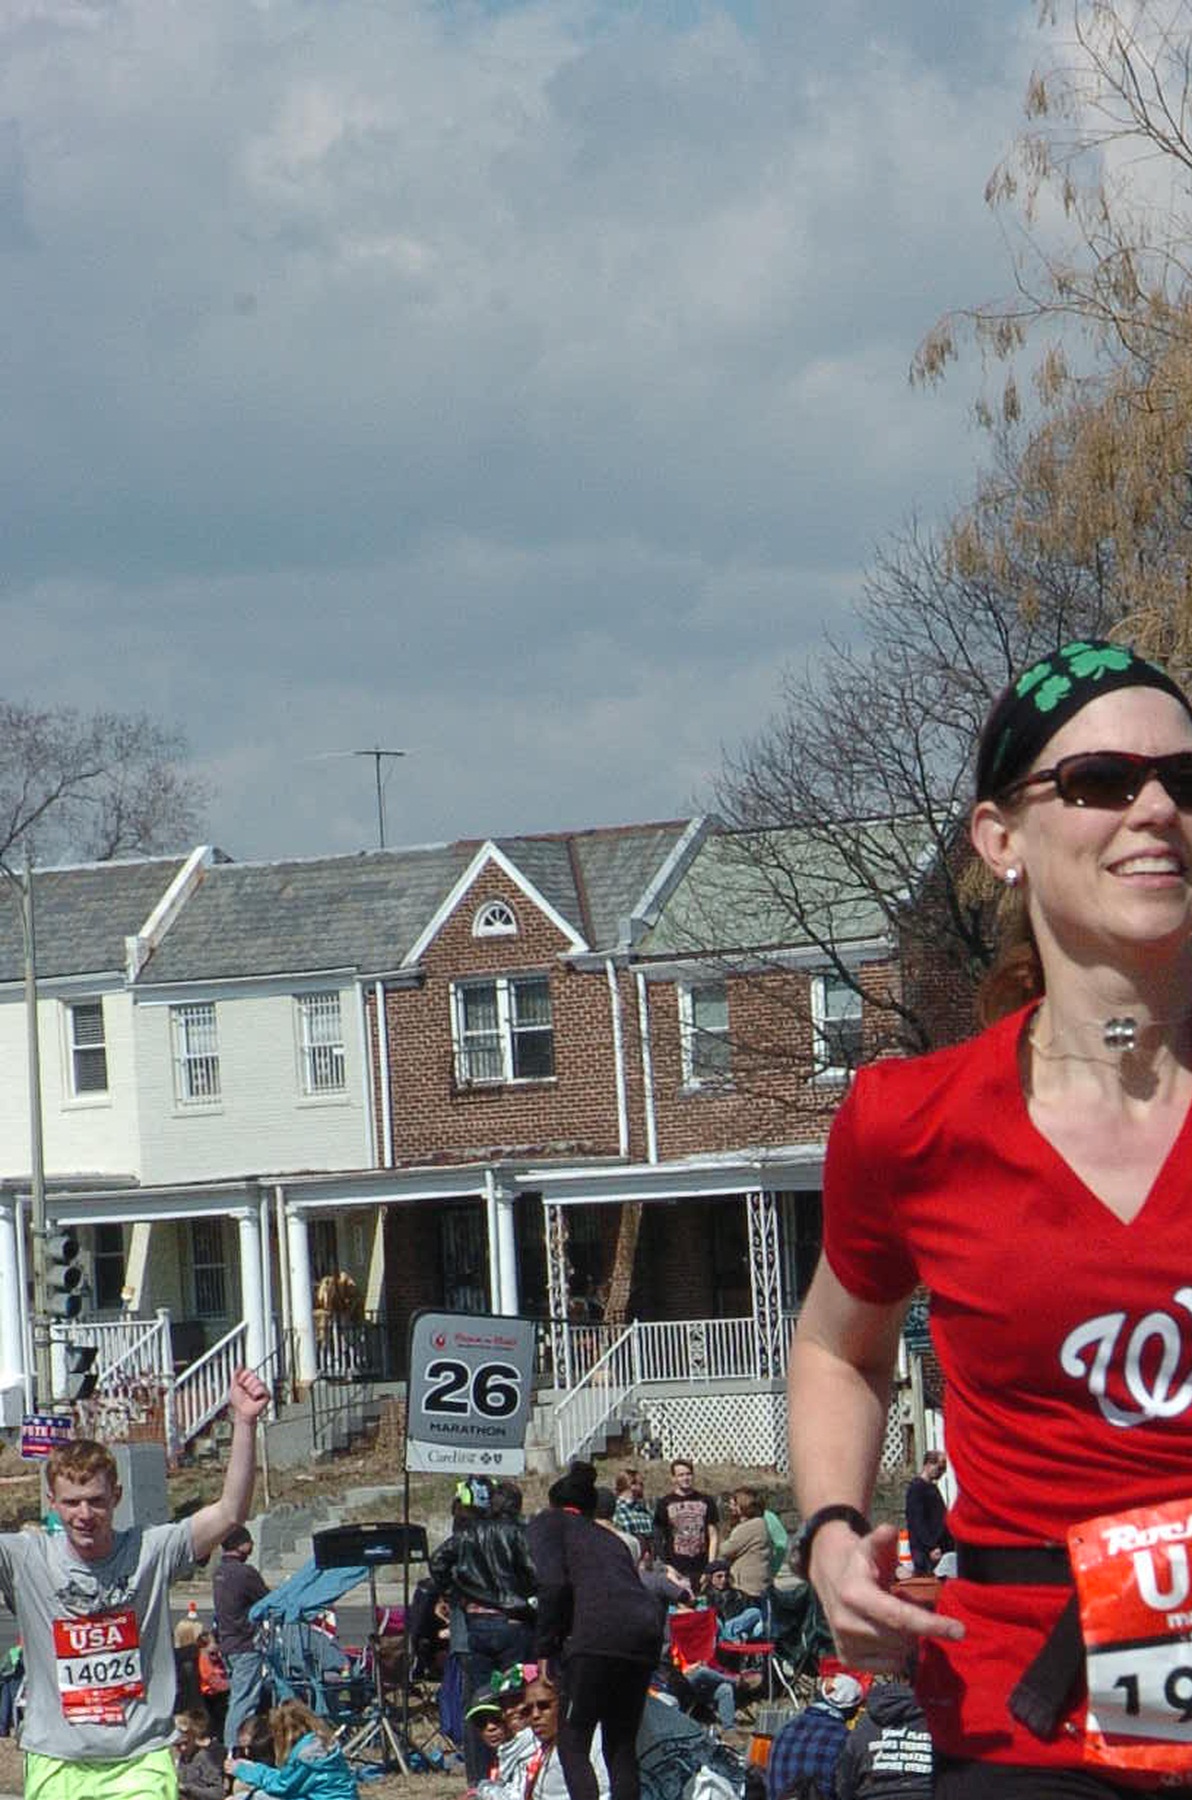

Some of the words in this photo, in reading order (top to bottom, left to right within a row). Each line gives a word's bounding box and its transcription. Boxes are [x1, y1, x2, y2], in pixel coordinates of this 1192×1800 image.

[422, 1358, 521, 1420] 26
[430, 1422, 506, 1437] MARATHON
[69, 1625, 124, 1650] USA
[64, 1656, 136, 1685] 14026
